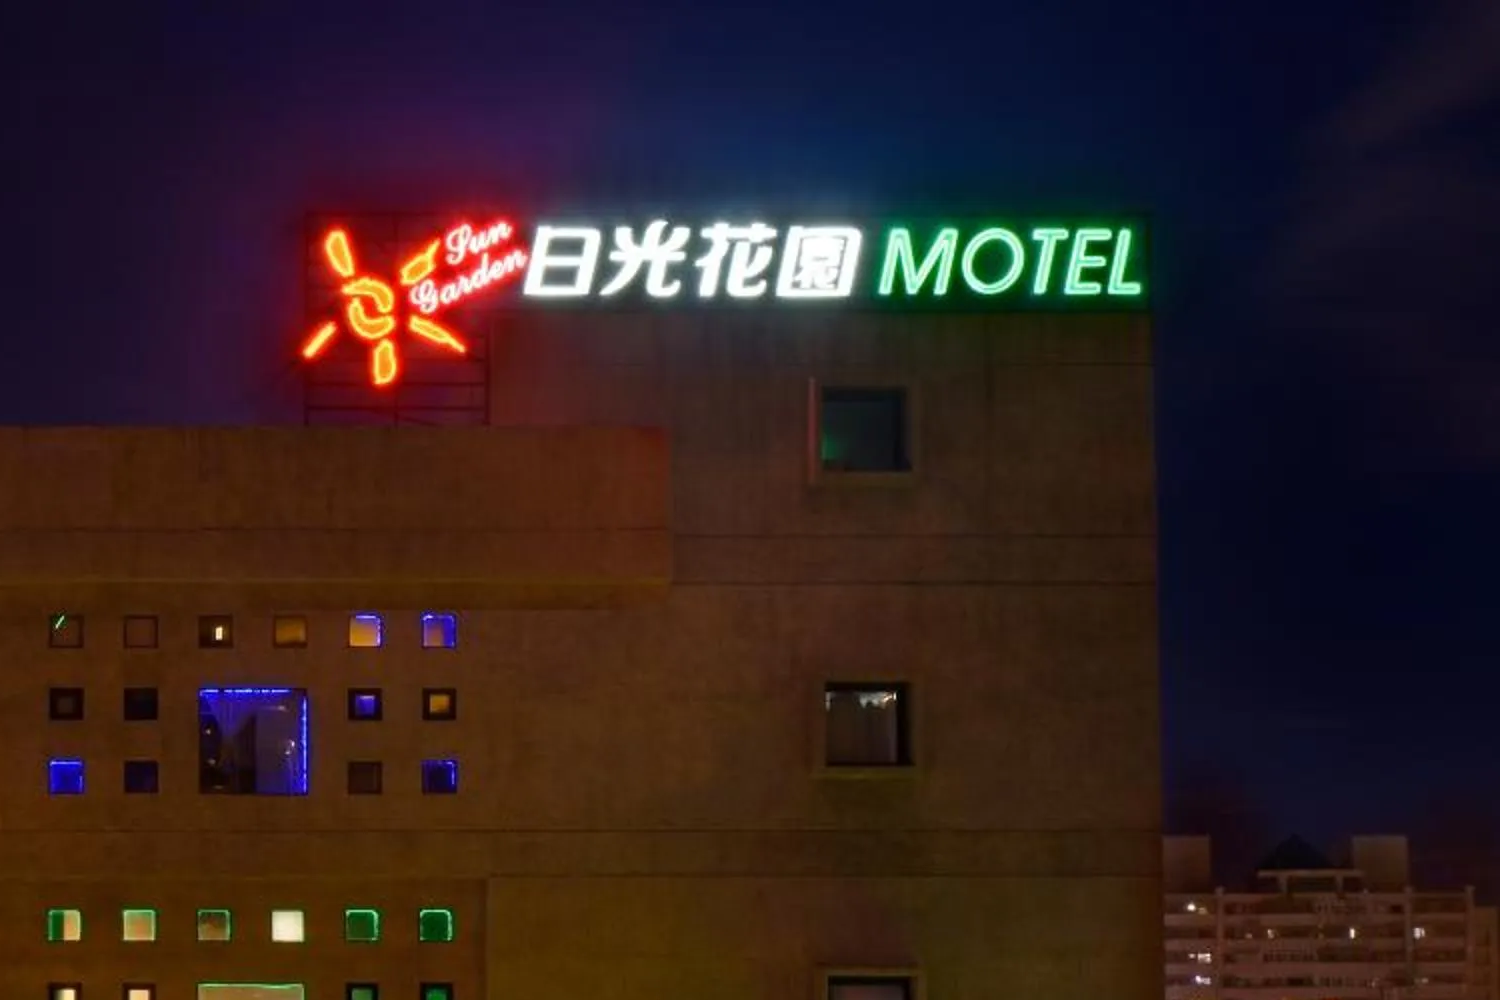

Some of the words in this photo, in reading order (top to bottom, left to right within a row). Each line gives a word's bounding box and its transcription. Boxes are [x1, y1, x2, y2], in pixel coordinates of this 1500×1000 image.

[445, 222, 513, 266] Sun
[521, 218, 864, 300] 日光花園
[876, 226, 1143, 297] MOTEL
[408, 248, 529, 315] Garden
